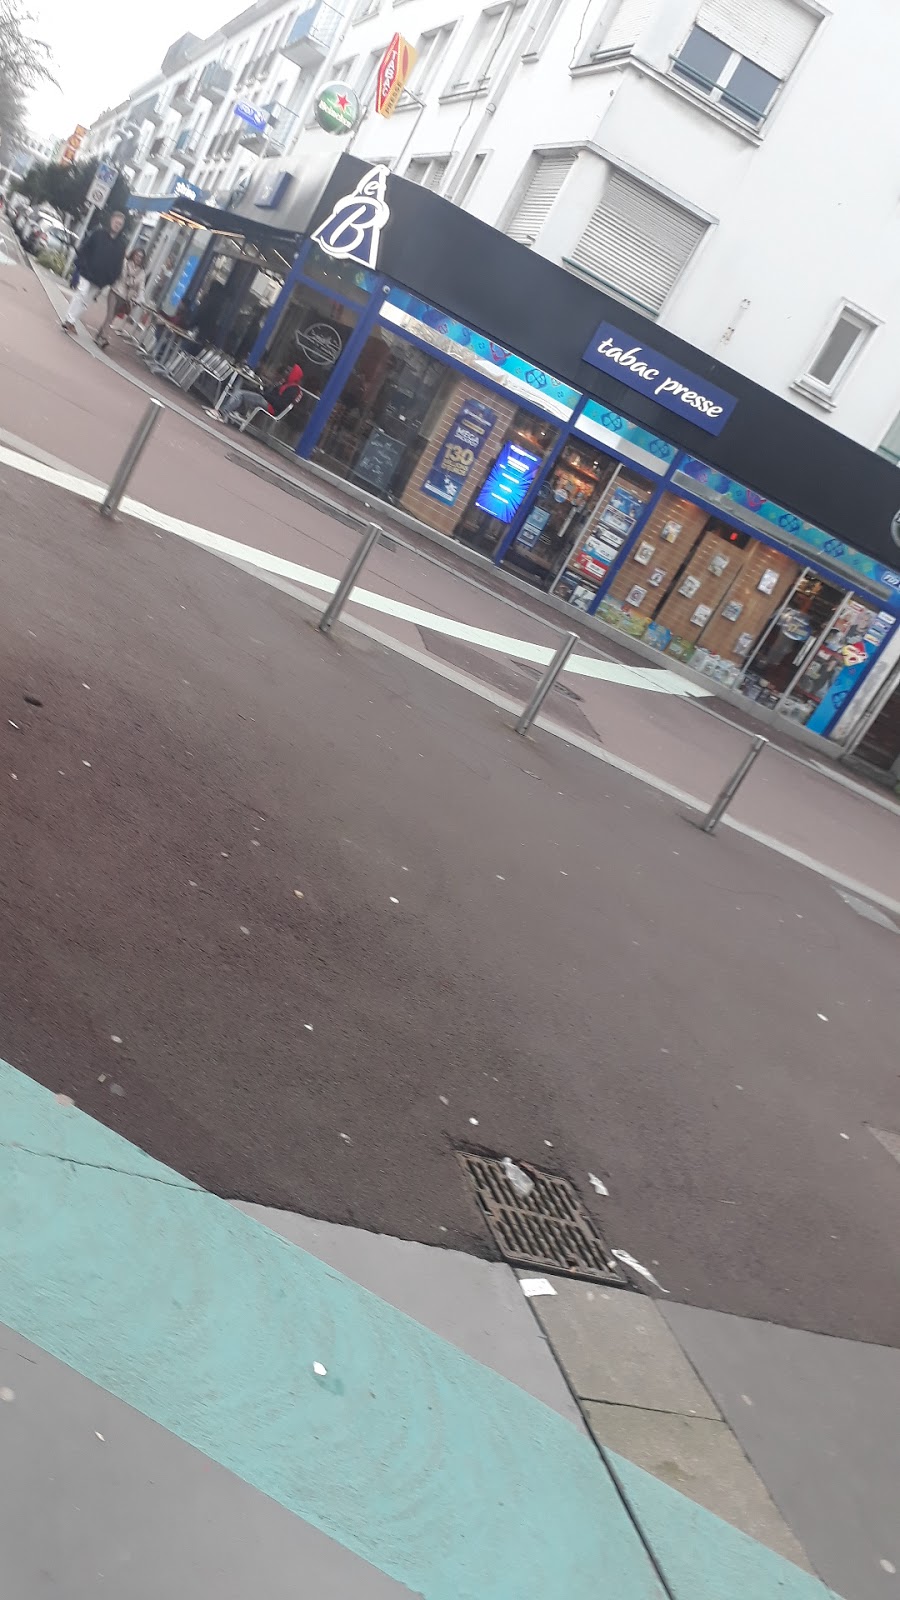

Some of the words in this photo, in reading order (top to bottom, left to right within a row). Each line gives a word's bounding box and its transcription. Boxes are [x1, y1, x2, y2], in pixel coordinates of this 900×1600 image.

[382, 49, 398, 97] TABAC
[385, 82, 402, 114] PRESSE
[597, 338, 660, 380] tabac
[654, 377, 723, 417] presse
[445, 443, 474, 466] 130
